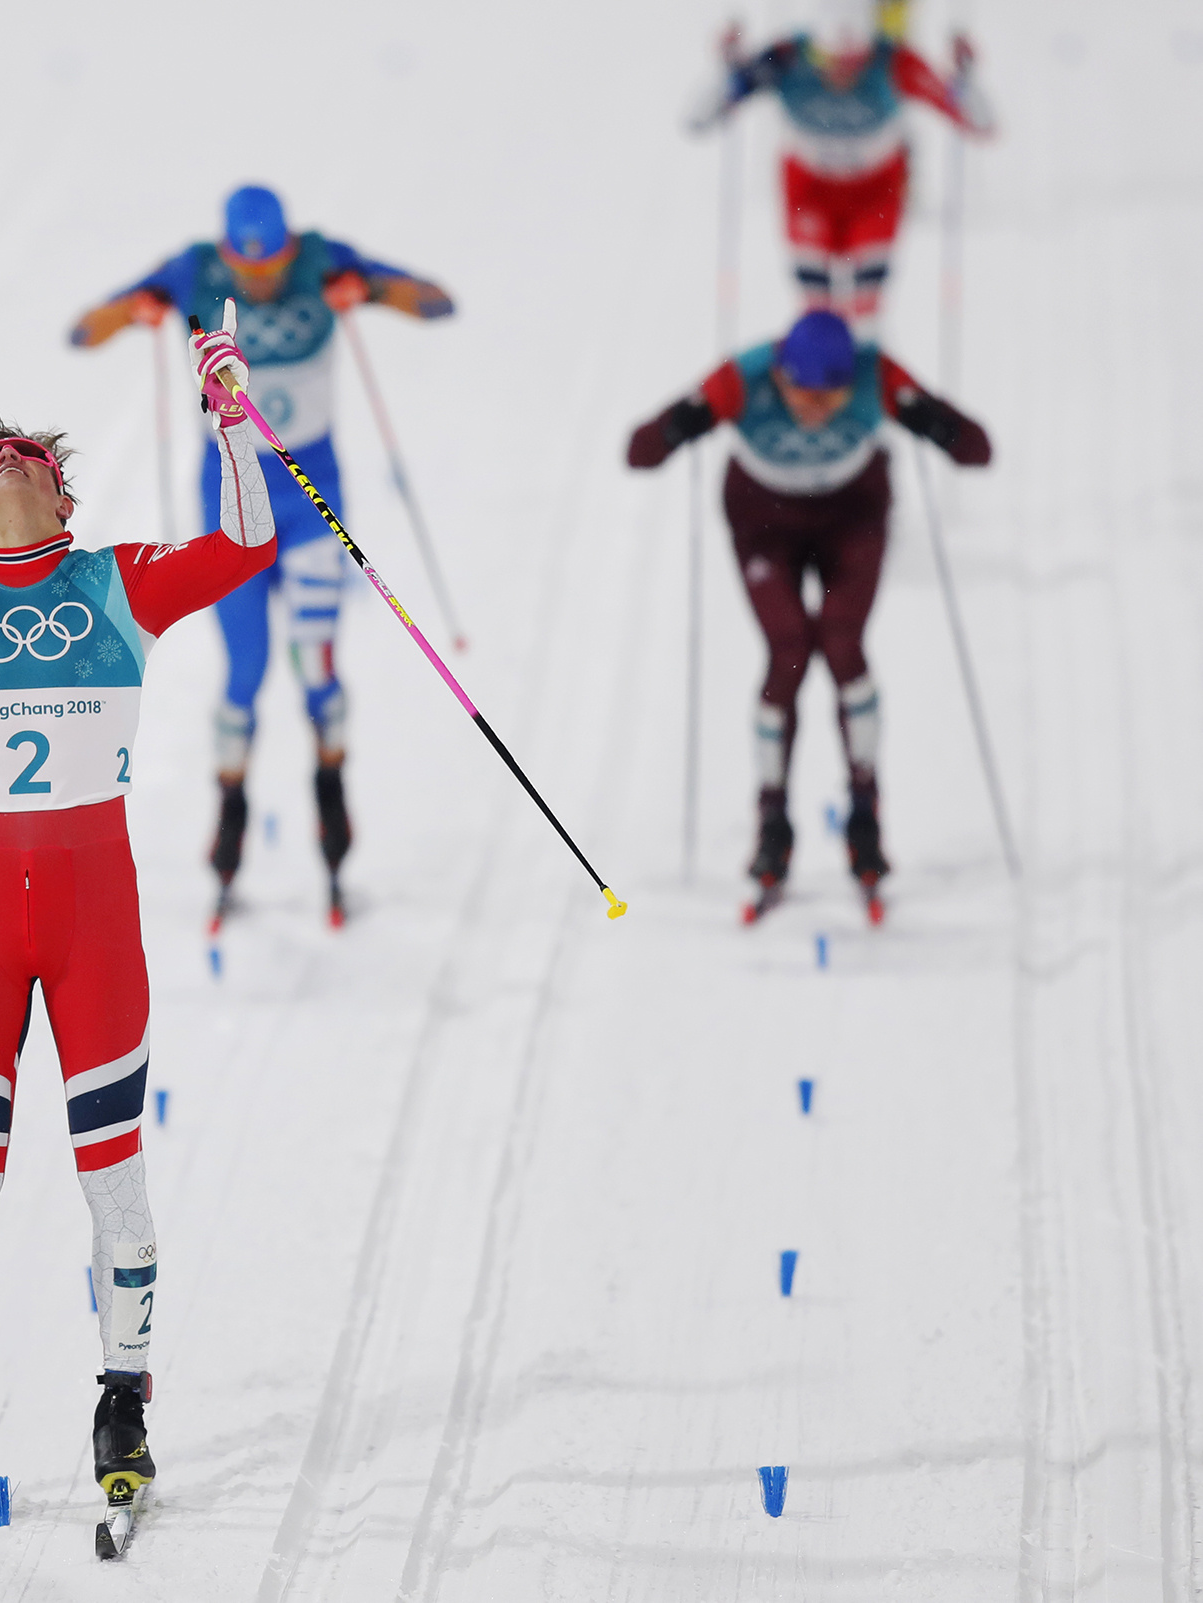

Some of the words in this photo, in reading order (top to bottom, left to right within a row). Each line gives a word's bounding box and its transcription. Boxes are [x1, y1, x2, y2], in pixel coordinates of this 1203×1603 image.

[67, 700, 102, 714] 2018
[6, 730, 51, 794] 2
[116, 746, 131, 783] 2
[137, 1290, 154, 1335] 2
